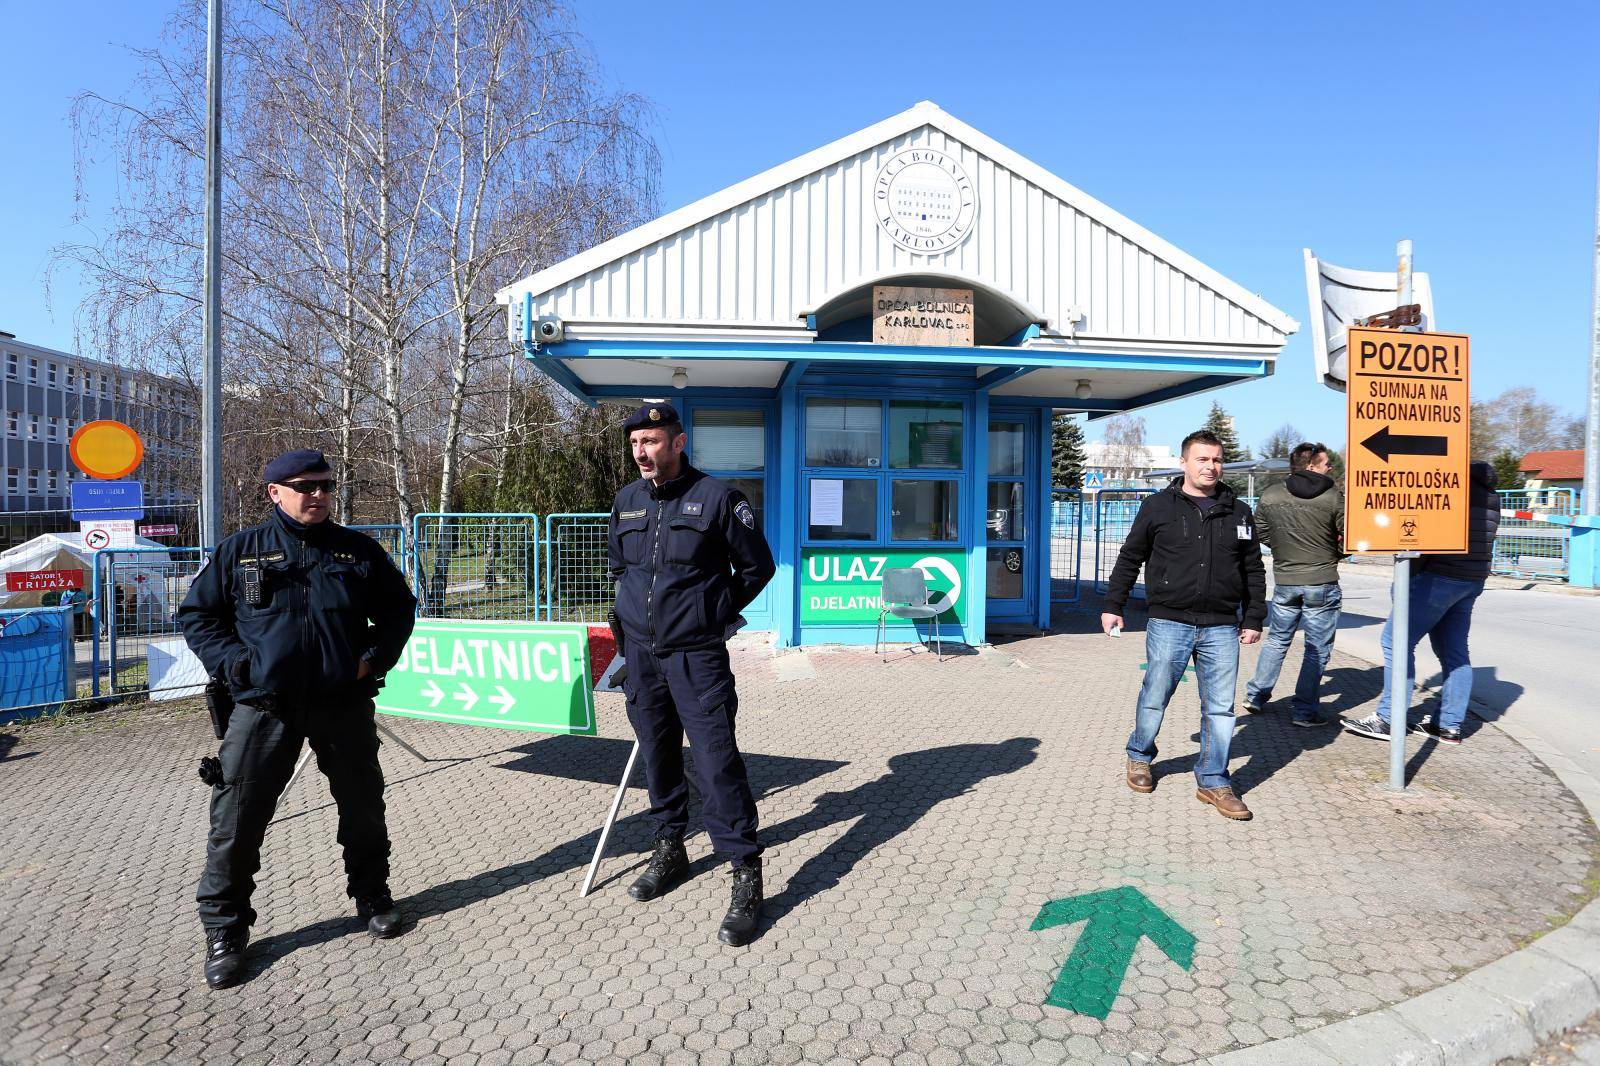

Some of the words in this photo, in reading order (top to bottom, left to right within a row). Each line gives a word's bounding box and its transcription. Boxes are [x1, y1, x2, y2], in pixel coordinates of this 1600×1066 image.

[882, 216, 964, 248] KARLOVAC
[917, 301, 971, 315] BOLNICA
[885, 315, 954, 330] KARLOVAC
[1369, 380, 1426, 400] SUMNJA
[1430, 384, 1448, 400] NA
[1355, 401, 1461, 424] KORONAVIRUS
[1356, 468, 1460, 489] INFEKTOLOŠKA
[1364, 492, 1451, 511] AMBULANTA
[30, 572, 56, 580] ŠATOR
[808, 556, 888, 582] ULAZ
[16, 577, 74, 590] TRIJAŽA
[810, 596, 894, 610] DJELATNI
[395, 635, 572, 684] JELATNICI
